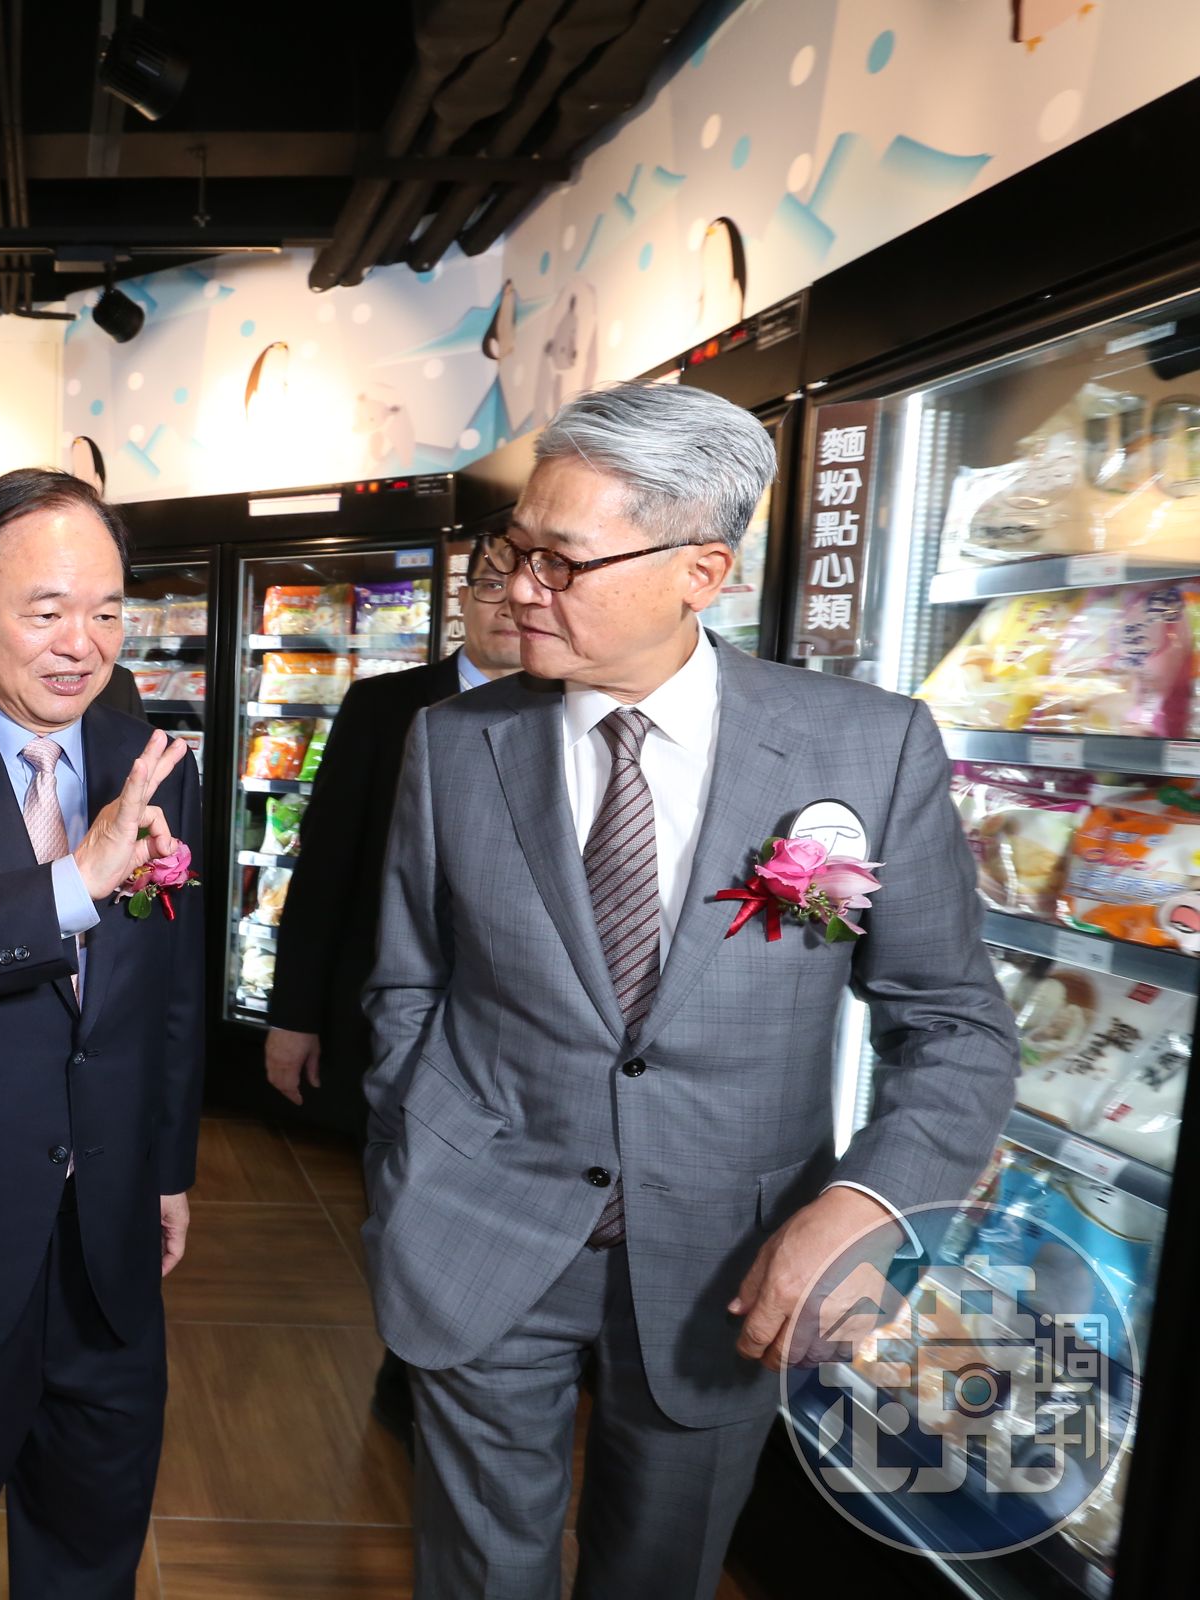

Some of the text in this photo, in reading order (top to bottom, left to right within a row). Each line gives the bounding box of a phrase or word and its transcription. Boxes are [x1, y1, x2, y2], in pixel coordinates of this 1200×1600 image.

[806, 424, 868, 631] 麵粉點心類
